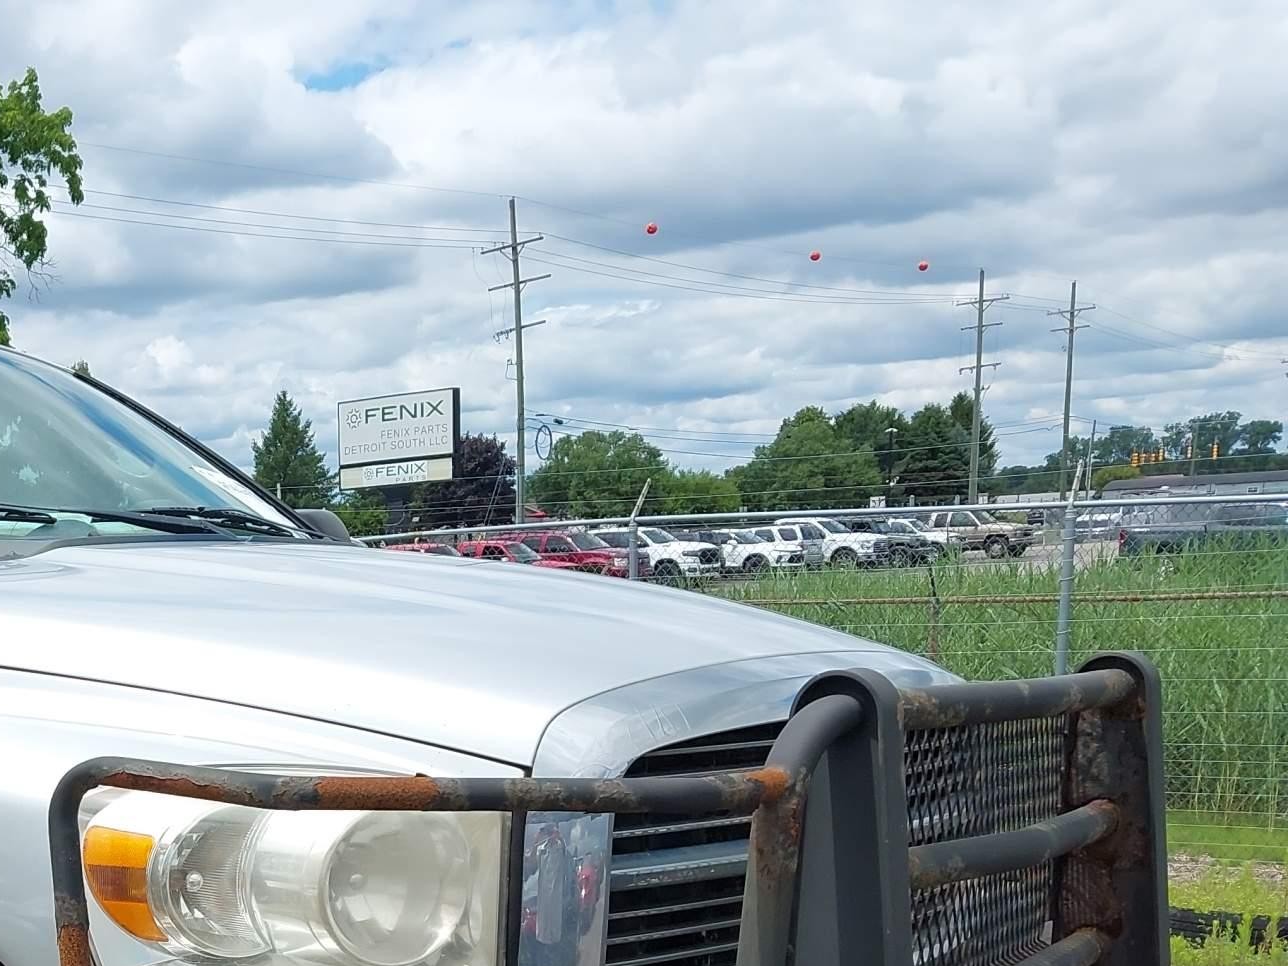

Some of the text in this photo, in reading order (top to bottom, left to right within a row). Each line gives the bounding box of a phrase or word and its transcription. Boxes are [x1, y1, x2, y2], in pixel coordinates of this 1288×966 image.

[364, 400, 444, 424] FENIX
[380, 423, 448, 440] FENIX PARTS
[344, 435, 448, 456] DETROIT SOUTH LLC
[375, 462, 425, 477] FENIX
